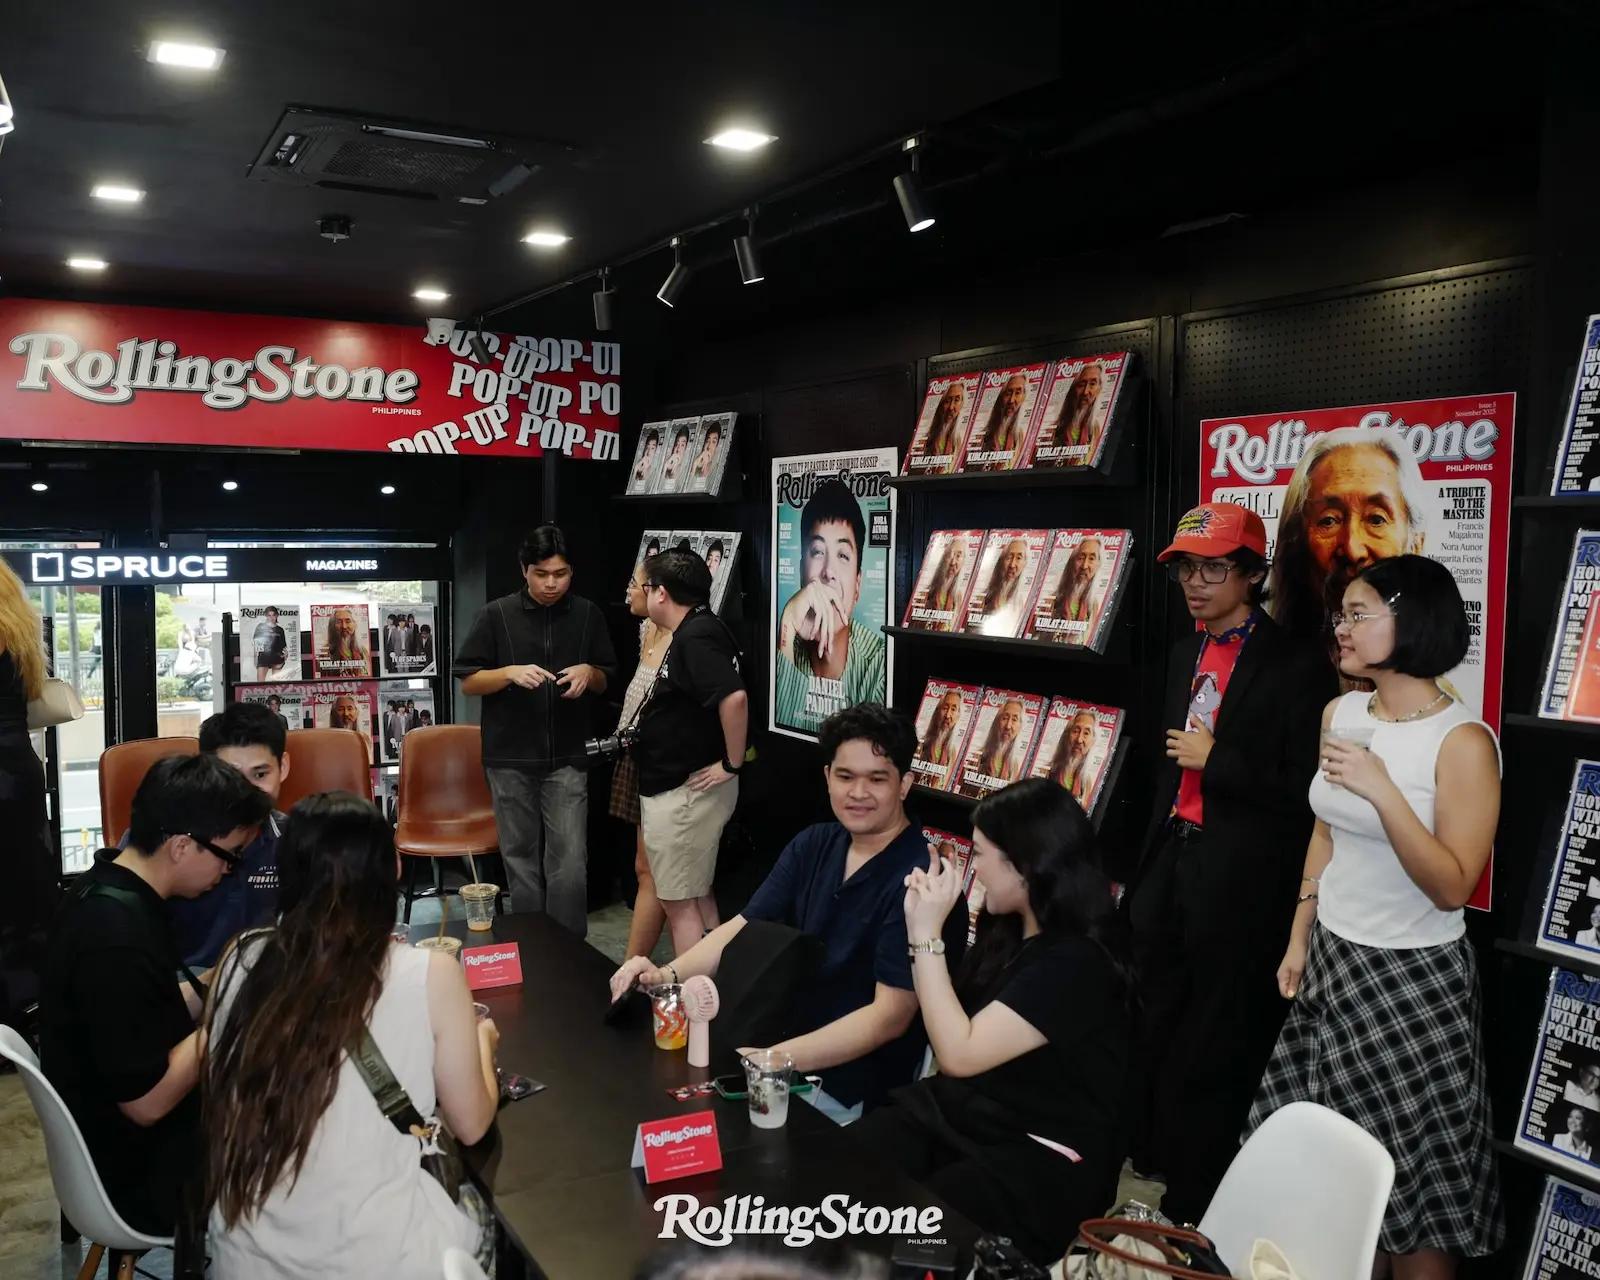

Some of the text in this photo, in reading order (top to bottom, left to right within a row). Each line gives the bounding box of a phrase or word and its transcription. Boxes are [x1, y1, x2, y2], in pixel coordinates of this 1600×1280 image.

[1579, 376, 1600, 390] PO
[447, 361, 572, 418] POP-UP
[372, 407, 422, 416] PHILIPPINES
[860, 456, 878, 468] GOSSIP
[1446, 464, 1493, 472] PHILIPPINES
[1439, 487, 1486, 498] A TRIBUTE
[1453, 498, 1485, 509] TO THE
[1443, 509, 1485, 520] MASTERS
[1457, 522, 1484, 531] Francis
[1449, 531, 1484, 541] Magalona
[1442, 543, 1483, 552] Nora Aunor
[1463, 554, 1483, 564] Forés
[71, 555, 228, 578] SPRUCE
[306, 560, 378, 571] MAGAZINES
[1568, 594, 1592, 608] PO
[1552, 994, 1585, 1014] HOW
[1551, 1007, 1598, 1034] WIN IN
[1545, 1020, 1600, 1052] POLITIC
[1549, 1214, 1582, 1238] HOW
[1547, 1227, 1593, 1259] WIN IN
